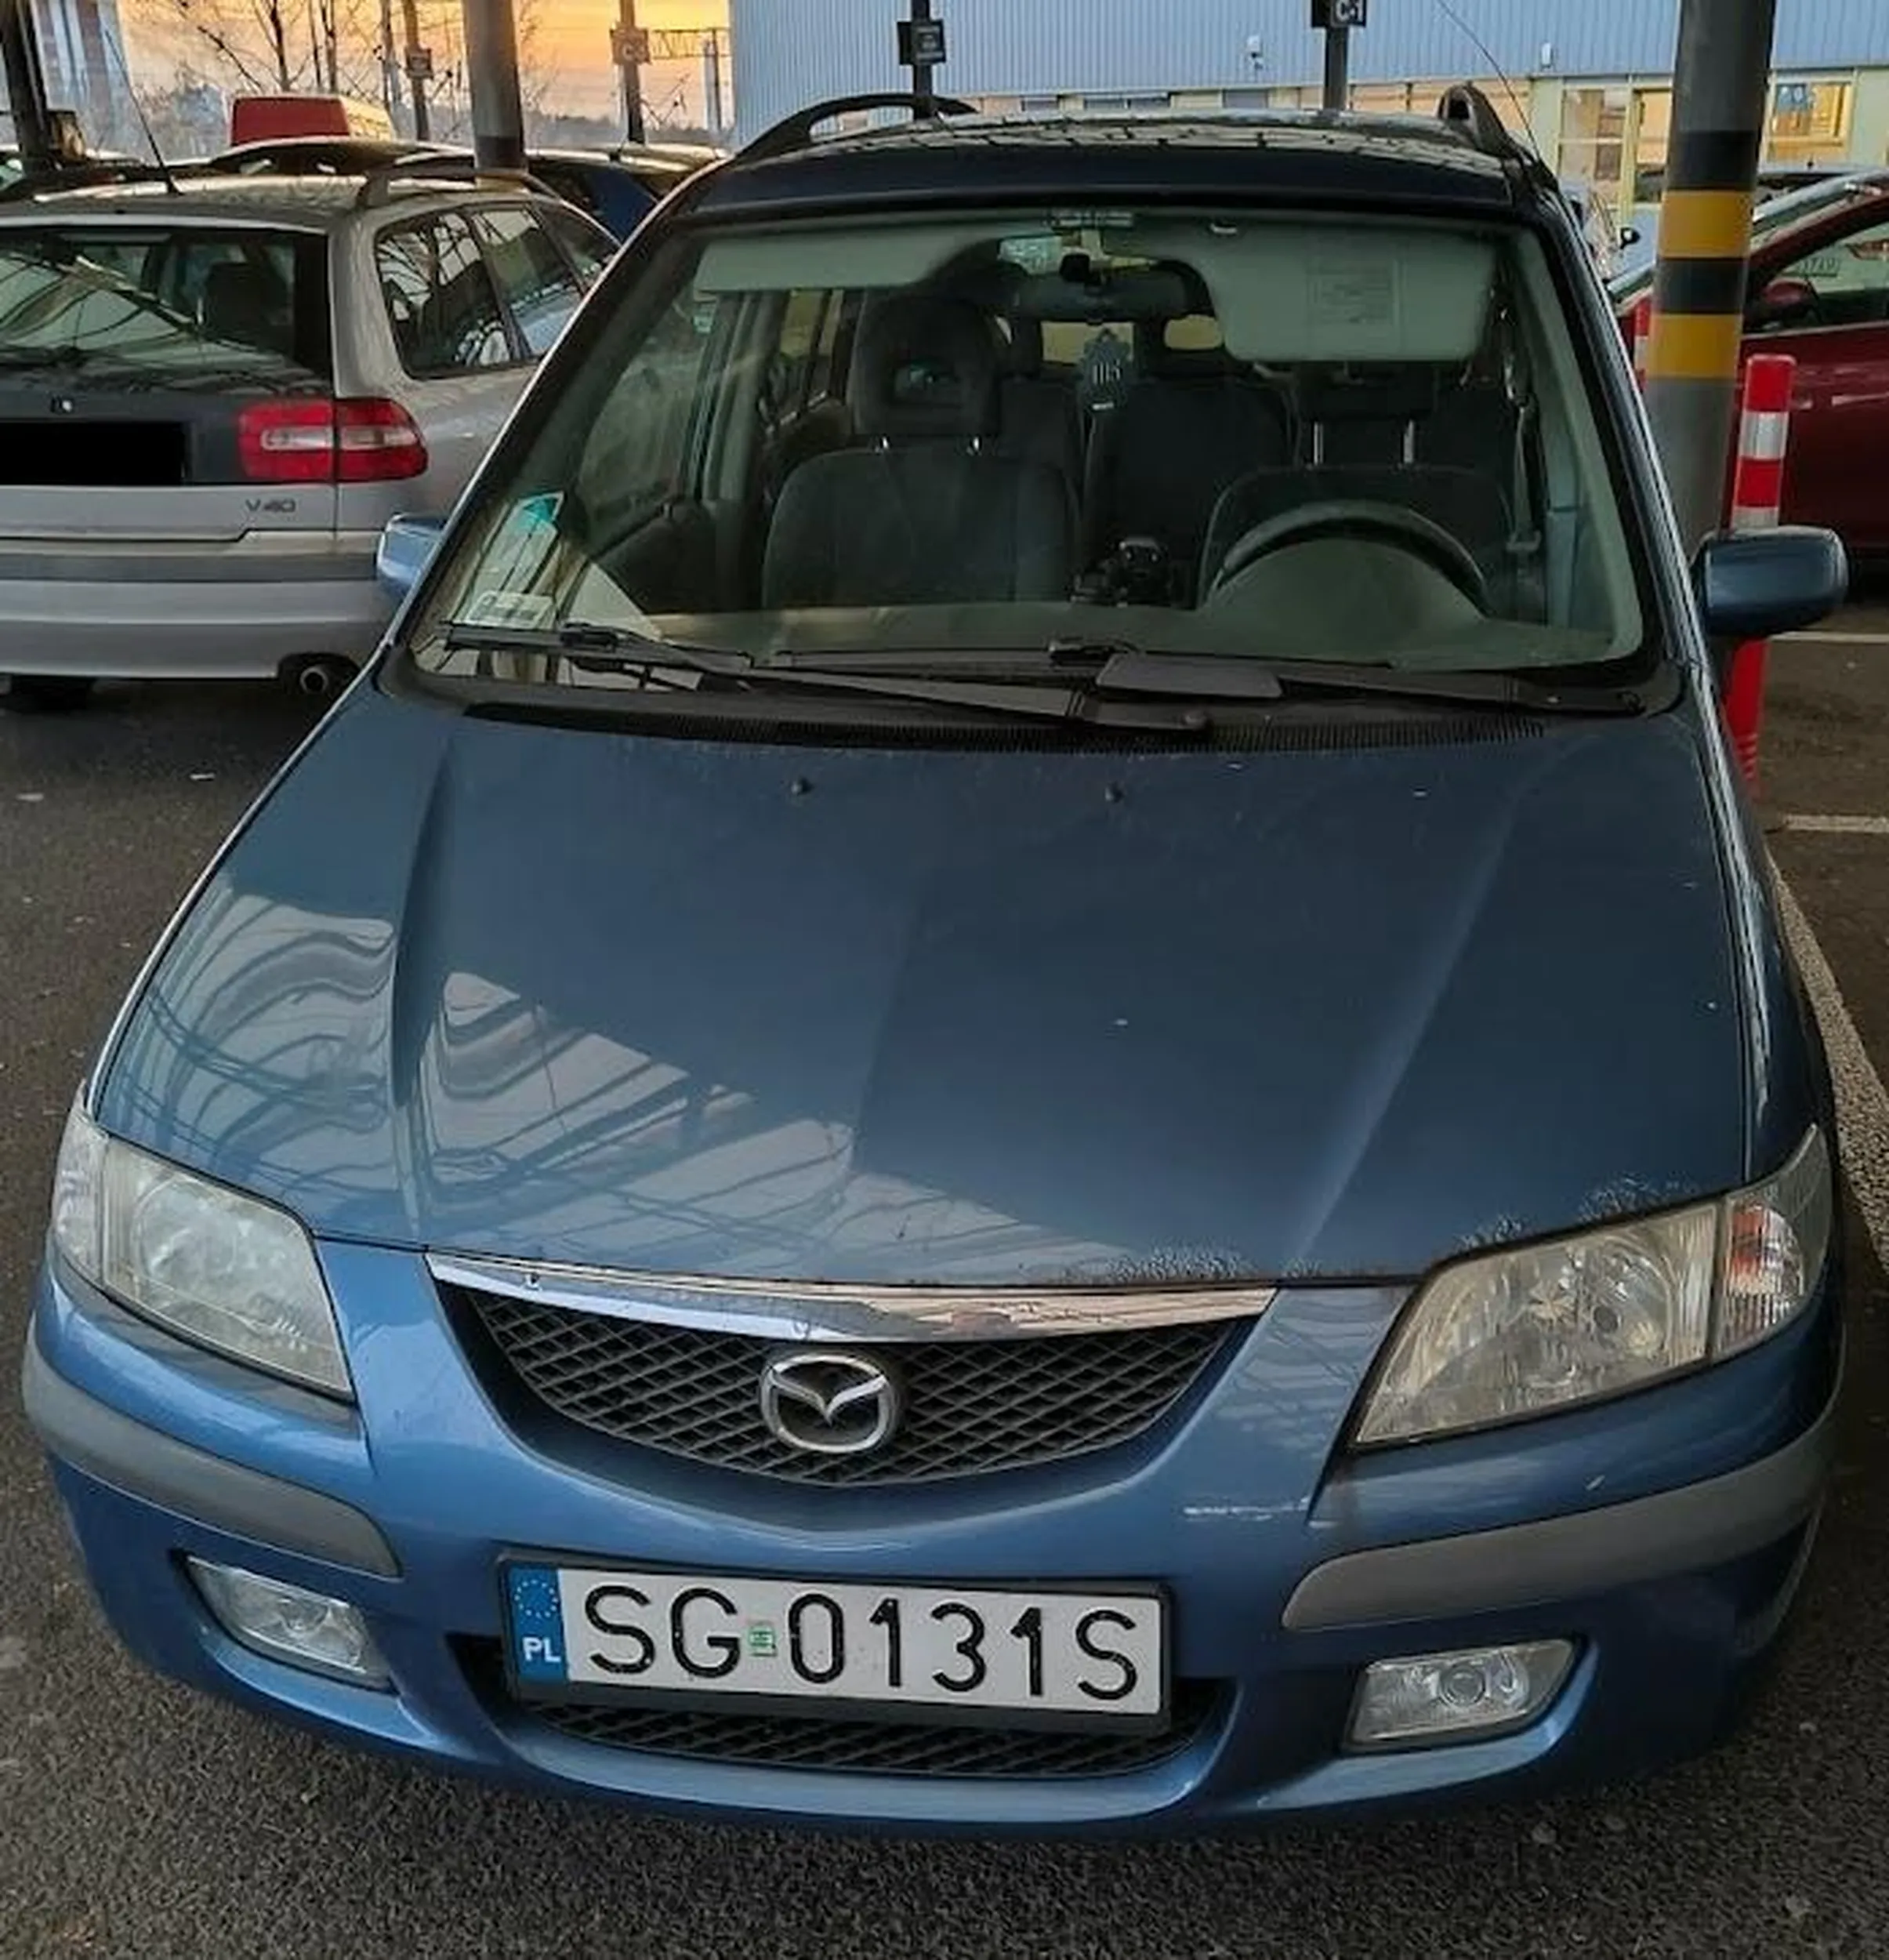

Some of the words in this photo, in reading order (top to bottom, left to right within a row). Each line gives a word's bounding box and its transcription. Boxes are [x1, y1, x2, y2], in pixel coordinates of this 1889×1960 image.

[245, 498, 296, 514] V40
[522, 1636, 561, 1662] PL
[583, 1584, 742, 1678] SG
[788, 1592, 1138, 1700] 0131S
